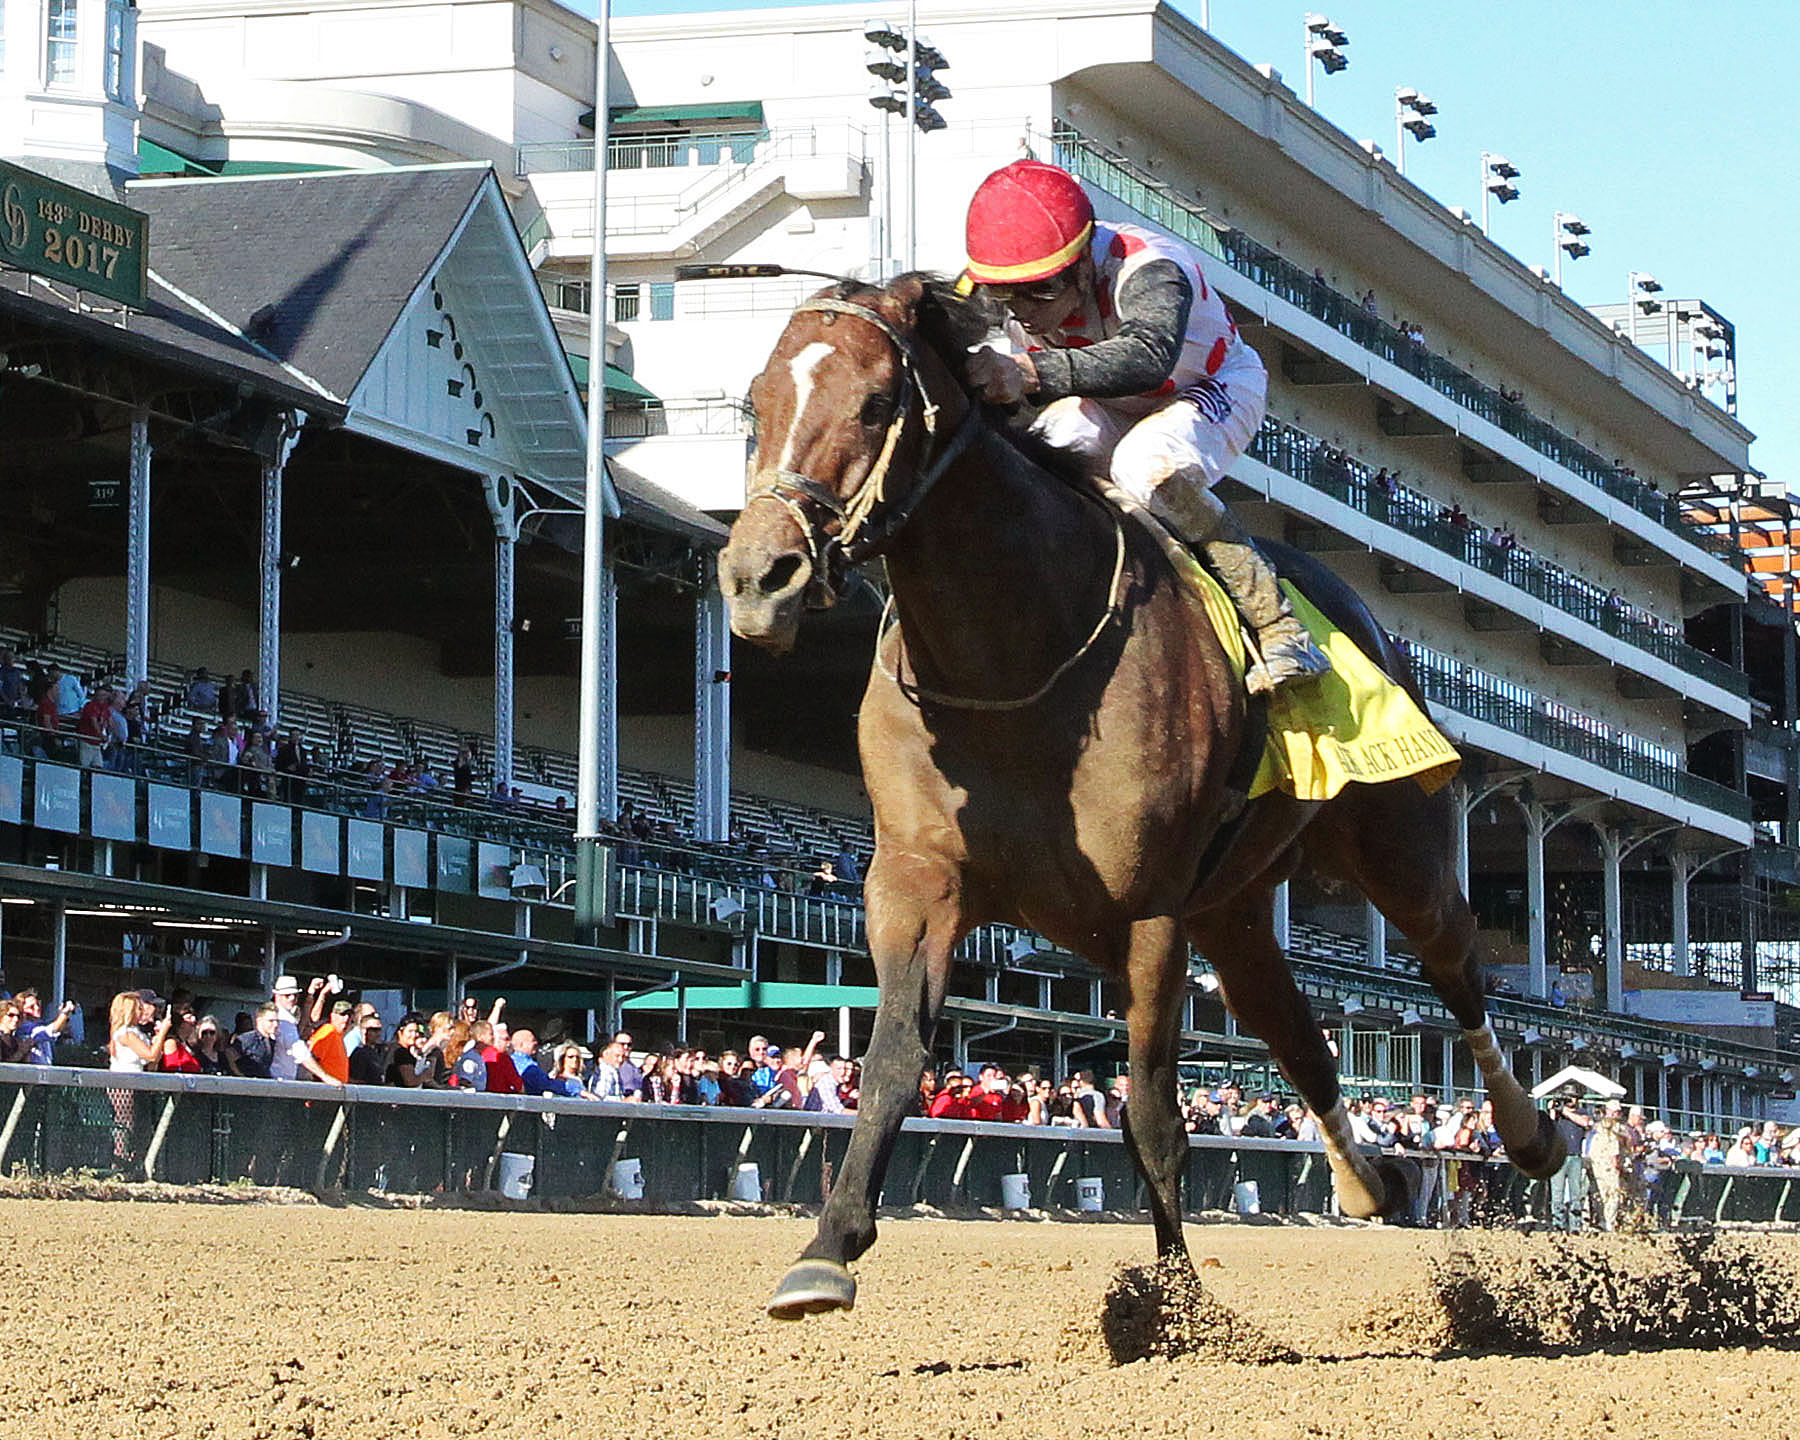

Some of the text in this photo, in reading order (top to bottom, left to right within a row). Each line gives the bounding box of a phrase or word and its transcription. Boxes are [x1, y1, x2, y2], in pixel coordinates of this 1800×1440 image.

[79, 211, 136, 249] DERBY
[44, 228, 120, 280] 2017
[1361, 741, 1398, 775] ACK
